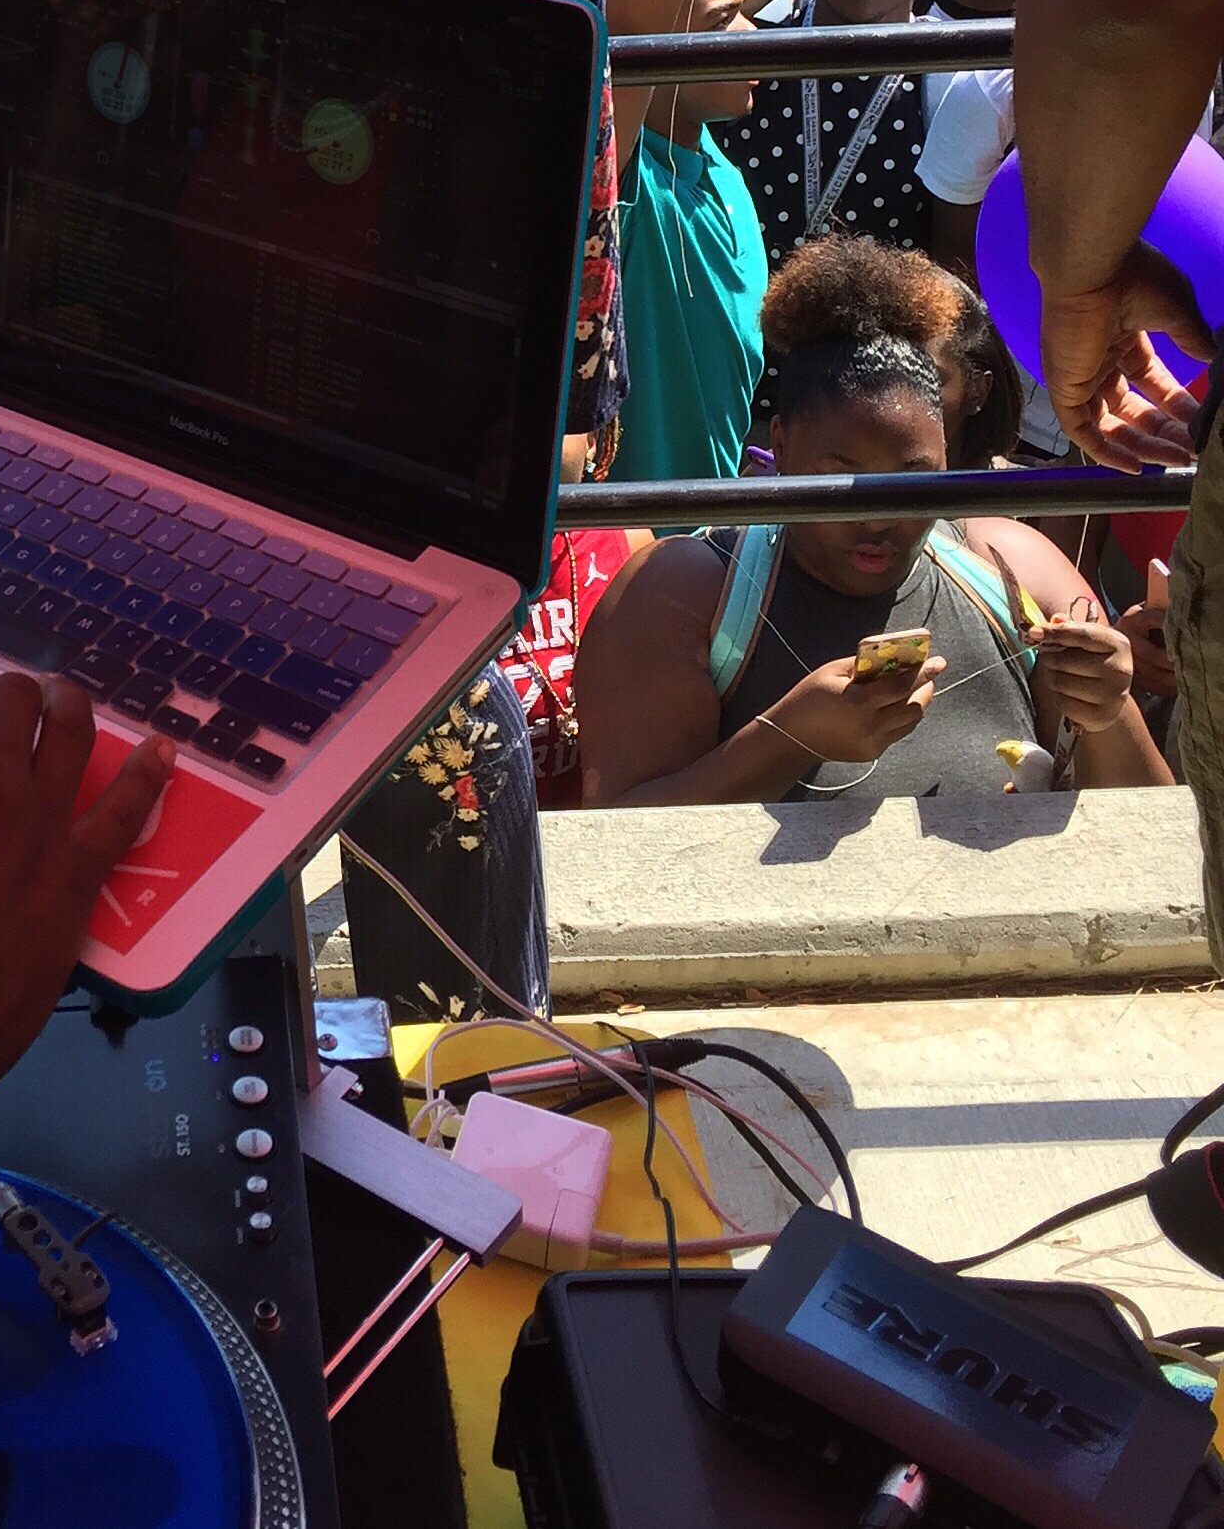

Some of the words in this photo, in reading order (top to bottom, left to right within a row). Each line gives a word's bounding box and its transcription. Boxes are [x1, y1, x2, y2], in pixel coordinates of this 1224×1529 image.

[168, 415, 210, 438] MacBook
[212, 430, 230, 447] Pro
[822, 1282, 1127, 1454] SHURE
